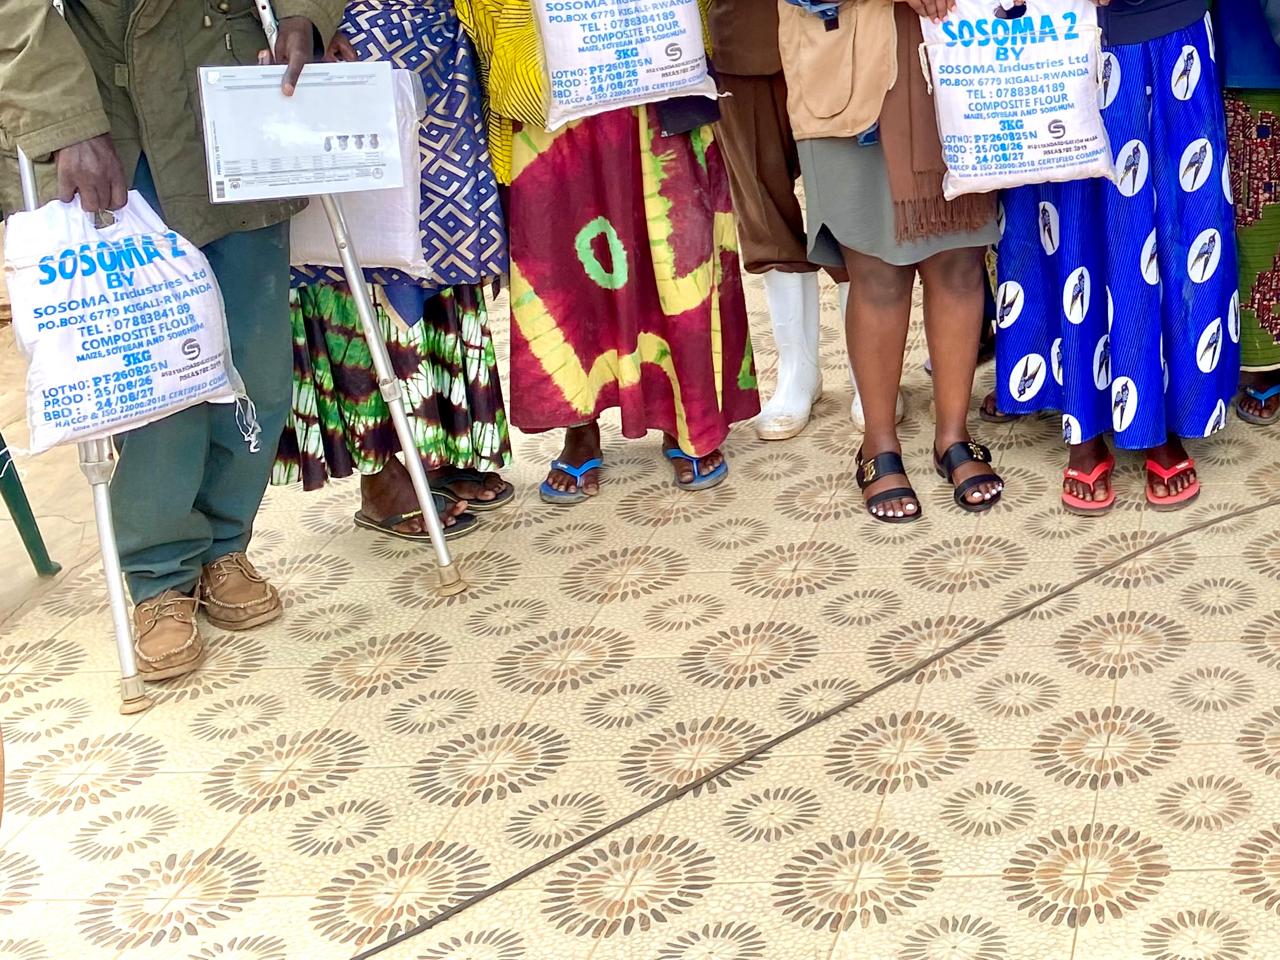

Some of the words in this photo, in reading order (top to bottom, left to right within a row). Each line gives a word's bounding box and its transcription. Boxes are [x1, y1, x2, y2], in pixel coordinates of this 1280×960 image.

[590, 10, 616, 21] 6779
[582, 28, 644, 45] COMPOSITE
[646, 20, 680, 36] FLOUR
[942, 15, 1059, 48] SOSOMA
[1062, 11, 1080, 40] 2
[614, 47, 640, 61] 3KG
[995, 46, 1025, 61] BY
[938, 64, 996, 75] SOSOMA
[998, 57, 1064, 73] Industries
[1068, 53, 1089, 65] Ltd
[977, 76, 1002, 87] 6779
[996, 82, 1066, 99] 0788384189
[968, 98, 1031, 112] COMPOSITE
[1033, 93, 1069, 108] FLOUR
[998, 119, 1025, 132] 3KG
[38, 234, 166, 286] SOSOMA
[164, 232, 187, 259] 2
[106, 271, 135, 290] BY
[33, 294, 110, 319] SOSOMA
[113, 278, 182, 303] Industries
[185, 269, 207, 284] Ltd
[77, 324, 103, 338] TEL
[114, 303, 191, 330] 0788384189
[89, 308, 120, 322] 6779
[81, 325, 157, 352] COMPOSITE
[159, 314, 196, 333] FLOUR
[146, 334, 165, 348] AND
[122, 349, 153, 368] 3KG
[44, 393, 84, 411] PROD
[94, 375, 154, 399] 25/08/26
[44, 407, 73, 422] BBD
[95, 387, 155, 411] 24/08/27
[101, 407, 117, 418] ISO
